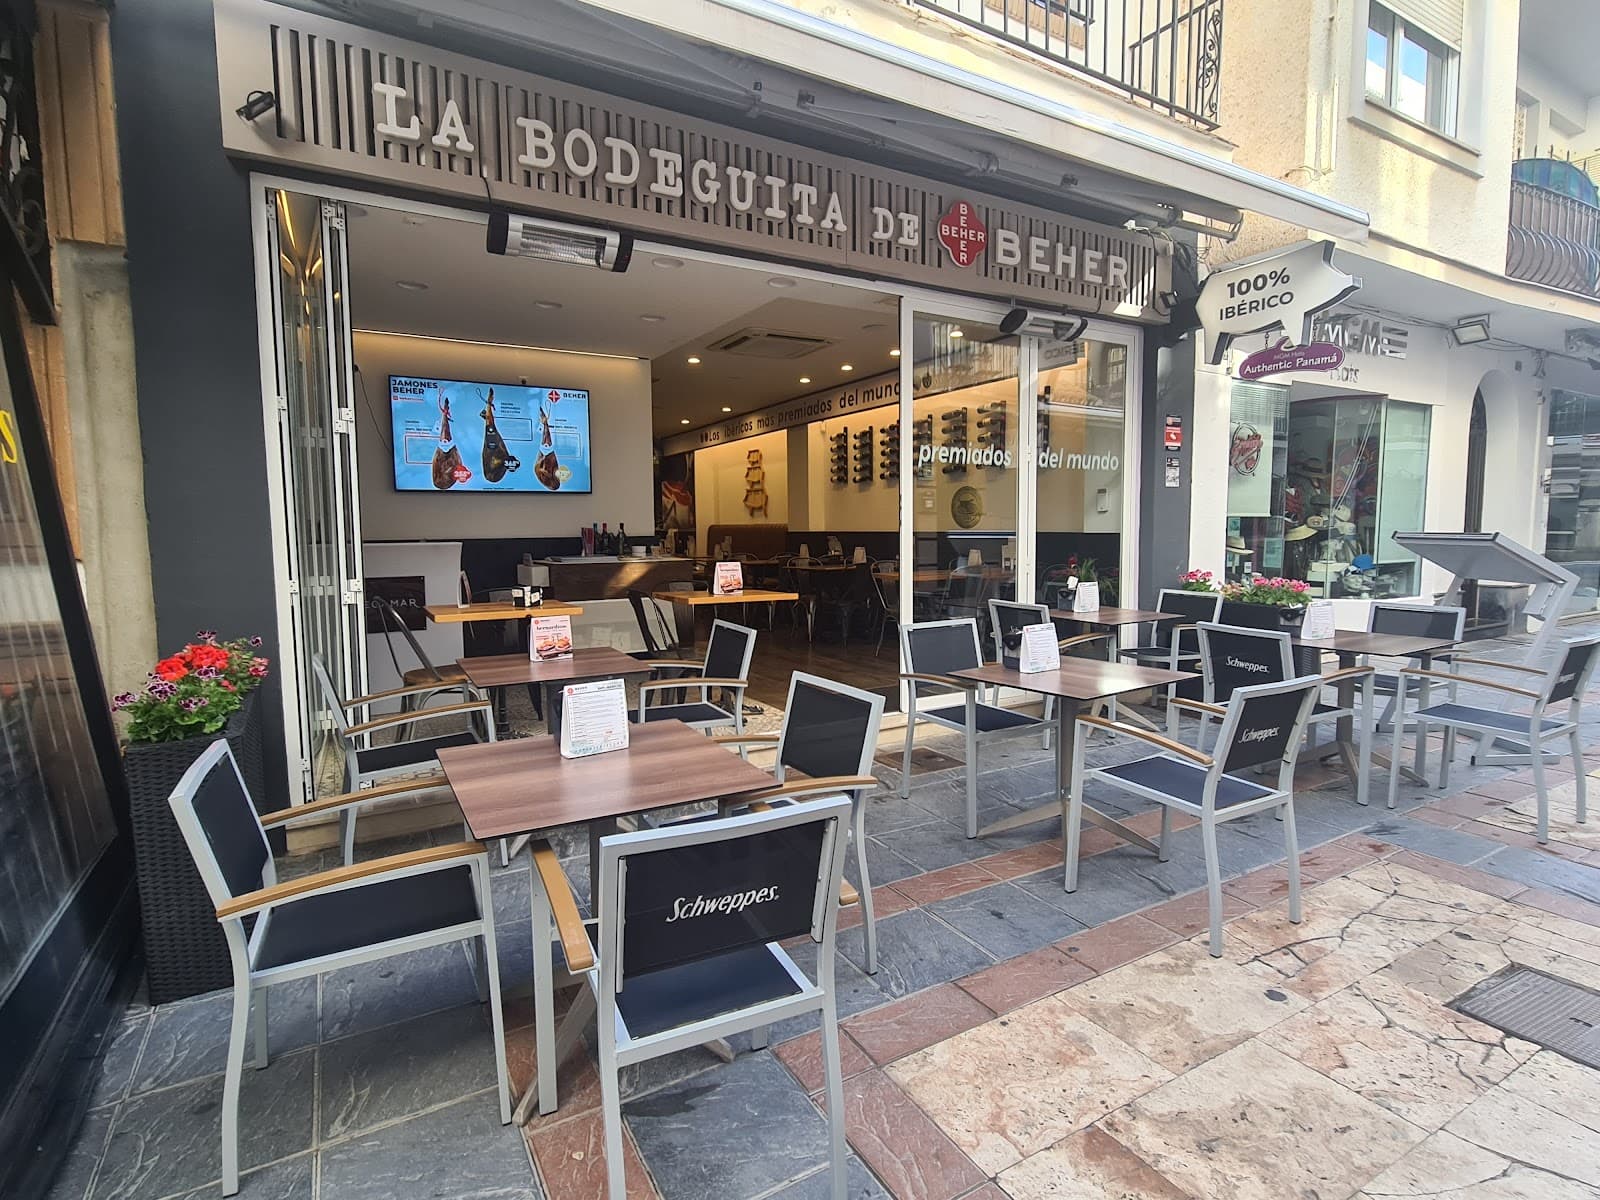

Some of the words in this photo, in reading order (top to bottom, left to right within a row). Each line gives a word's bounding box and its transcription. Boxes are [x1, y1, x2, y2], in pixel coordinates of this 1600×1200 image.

[373, 82, 475, 152] LA
[515, 116, 847, 232] BODEGUITA
[871, 206, 919, 246] DE
[941, 224, 985, 243] BEHER
[960, 203, 968, 264] BEHER
[995, 229, 1128, 290] BEHER
[1226, 267, 1290, 298] 100%
[1219, 291, 1294, 321] IBÉRICO
[1244, 360, 1293, 375] Authentic
[1296, 353, 1338, 368] Panamá
[392, 379, 438, 389] JAMONES
[392, 386, 425, 395] BEHER
[777, 400, 832, 425] premiados
[839, 389, 859, 408] del
[918, 443, 1013, 468] premiados
[1039, 447, 1063, 469] del
[1067, 451, 1119, 471] mundo
[1226, 655, 1268, 673] Schweppes
[665, 885, 779, 923] Schweppes
